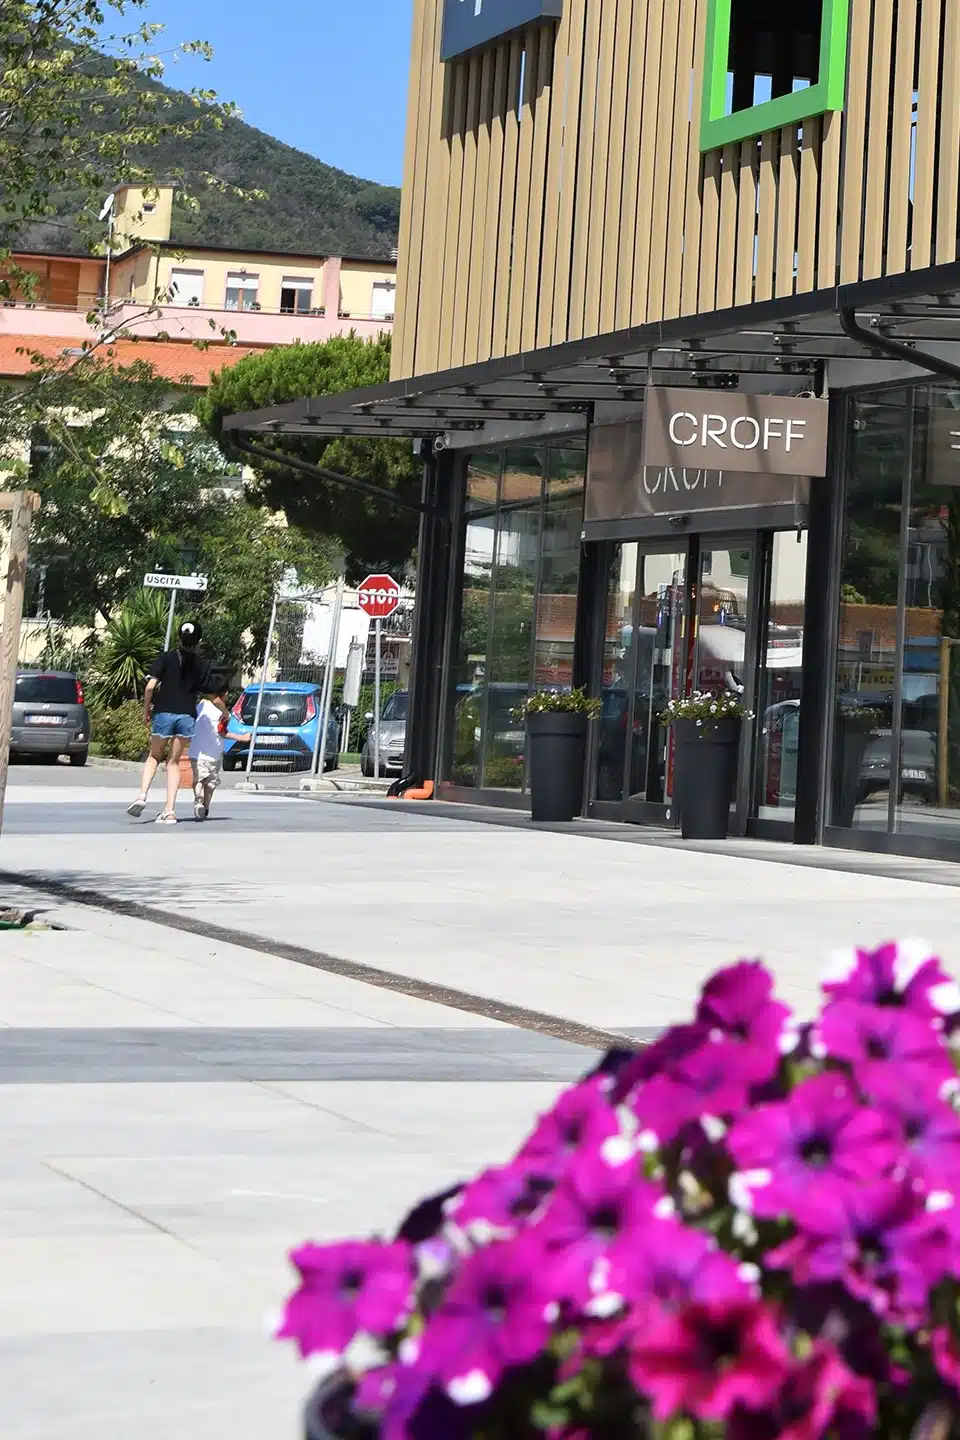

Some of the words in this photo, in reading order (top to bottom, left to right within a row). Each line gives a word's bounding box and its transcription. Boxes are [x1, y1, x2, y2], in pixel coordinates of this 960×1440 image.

[669, 412, 807, 452] CROFF
[146, 575, 181, 586] USCITA
[360, 587, 396, 605] STOP
